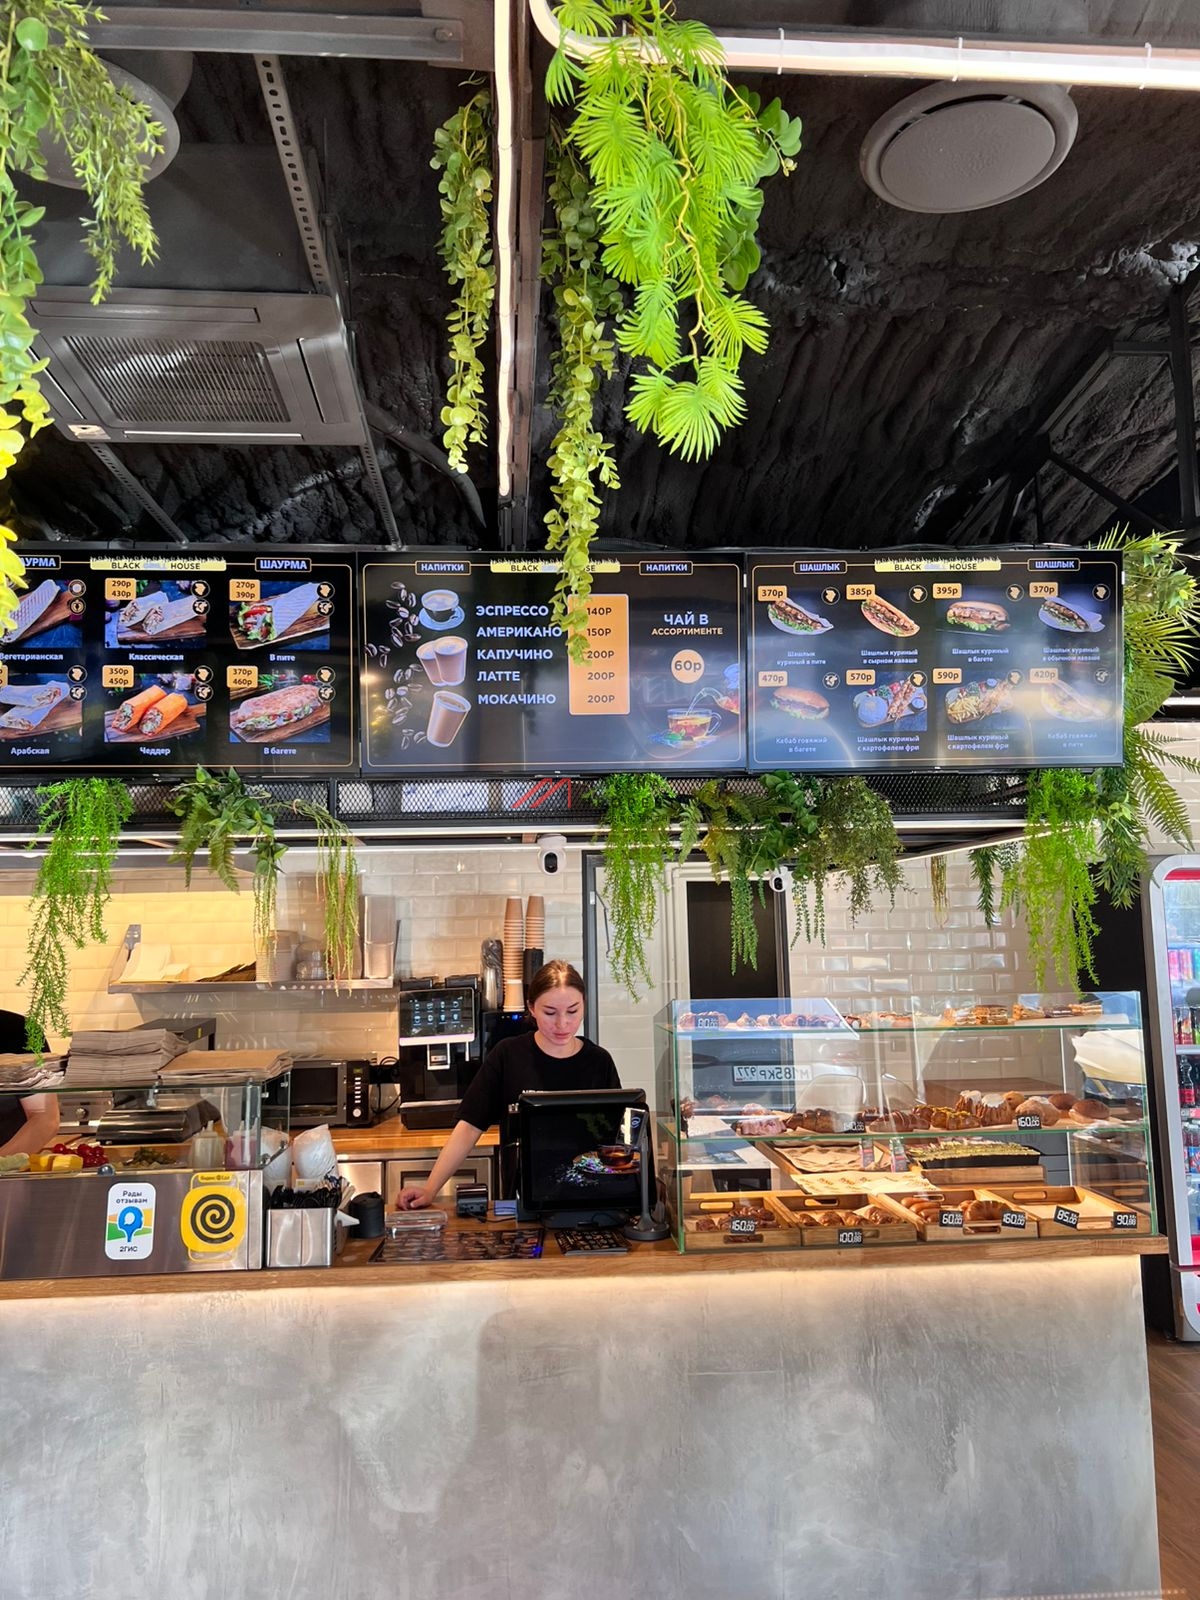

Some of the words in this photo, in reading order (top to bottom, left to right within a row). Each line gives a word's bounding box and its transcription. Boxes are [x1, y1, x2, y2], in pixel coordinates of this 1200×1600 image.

[111, 562, 141, 570] BLACK
[170, 562, 201, 570] HOUSE
[259, 559, 308, 570] ШАУРМА
[421, 563, 464, 572] НАПИТКИ
[510, 564, 539, 572] BLACK
[646, 563, 688, 572] НАПИТКИ
[800, 563, 840, 572] ШАШЛЫК
[949, 562, 977, 570] HOUSE
[1035, 560, 1075, 569] ШАШЛЫК
[112, 580, 132, 588] 290р
[236, 581, 255, 589] 270р
[112, 590, 132, 598] 430р
[761, 589, 784, 599] 370р
[850, 587, 872, 597] 385р
[936, 586, 958, 596] 395р
[1033, 585, 1055, 595] 370р
[236, 591, 256, 599] 390р
[476, 605, 549, 617] ЭСПРЕССО
[587, 607, 612, 616] 140Р
[664, 611, 694, 626] ЧАЙ
[699, 614, 709, 625] В
[476, 626, 562, 638] АМЕРИКАНО
[587, 628, 612, 637] 150Р
[651, 627, 723, 636] АССОРТИМЕНТЕ
[477, 649, 553, 660] КАПУЧИНО
[587, 650, 615, 659] 200Р
[890, 649, 918, 657] куриный
[981, 647, 1009, 656] куриный
[129, 653, 184, 661] Классическая
[269, 653, 276, 661] В
[277, 654, 296, 662] пите
[674, 660, 702, 673] 60р
[109, 668, 129, 676] 350р
[233, 668, 252, 677] 370р
[477, 671, 521, 682] ЛАТТЕ
[587, 672, 615, 681] 200Р
[937, 671, 959, 681] 590р
[1034, 670, 1056, 680] 420р
[761, 673, 784, 683] 470р
[850, 672, 872, 682] 570р
[109, 678, 129, 686] 450р
[233, 678, 252, 686] 460р
[478, 694, 556, 705] МОКАЧИНО
[587, 694, 615, 703] 200Р
[857, 735, 887, 743] Шашлык
[889, 735, 919, 744] куриный
[978, 733, 1008, 742] куриный
[11, 747, 50, 756] Арабская
[140, 747, 171, 756] Чеддер
[263, 747, 270, 755] В
[271, 747, 297, 755] багете
